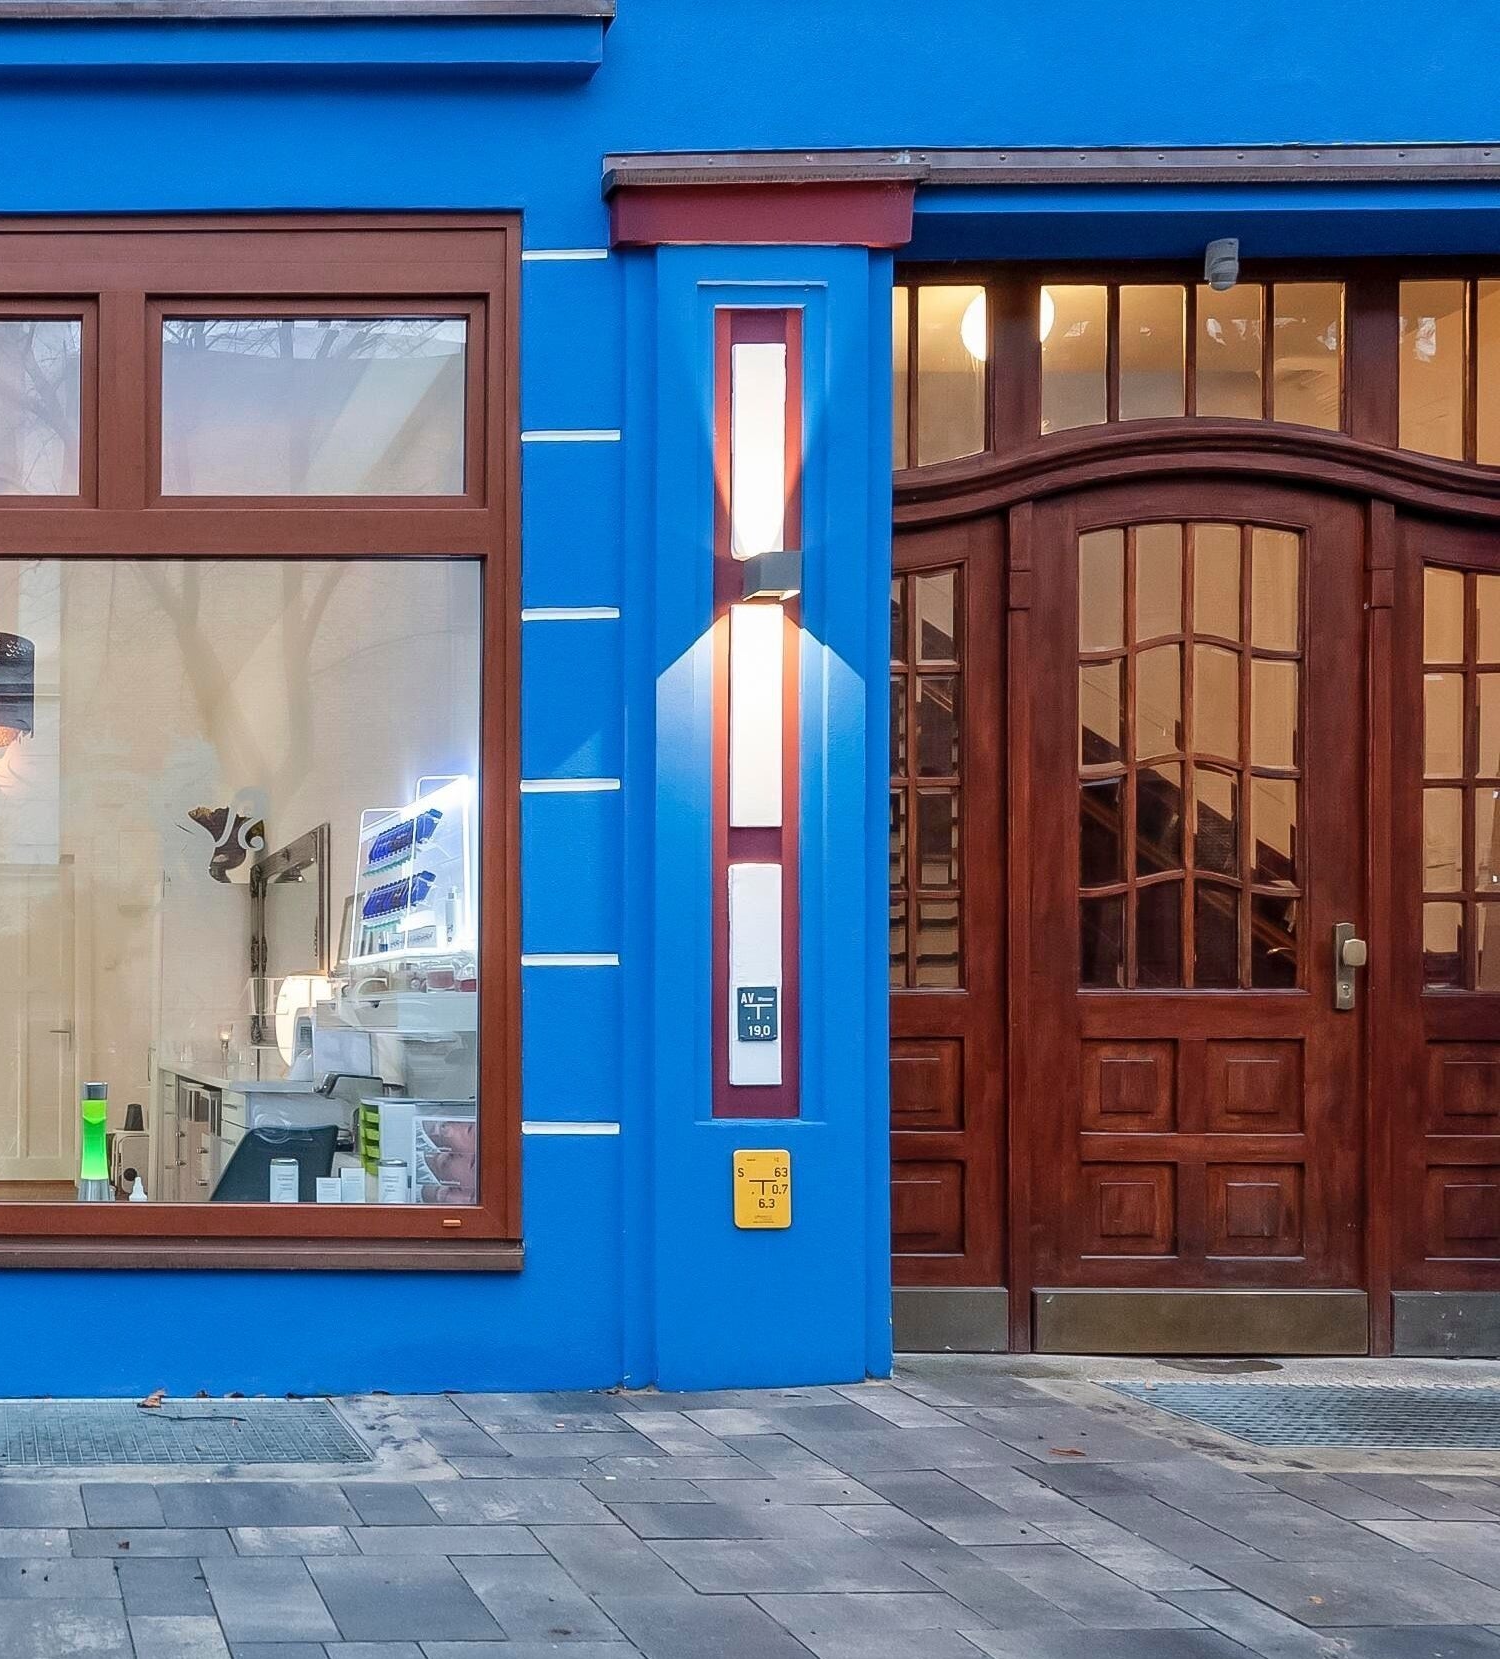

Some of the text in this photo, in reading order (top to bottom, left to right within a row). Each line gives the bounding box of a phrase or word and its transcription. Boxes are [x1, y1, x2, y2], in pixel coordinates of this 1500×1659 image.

[740, 992, 755, 1004] AV
[737, 1167, 788, 1178] S 63
[771, 1184, 789, 1195] 0.7
[758, 1198, 775, 1209] 6.3
